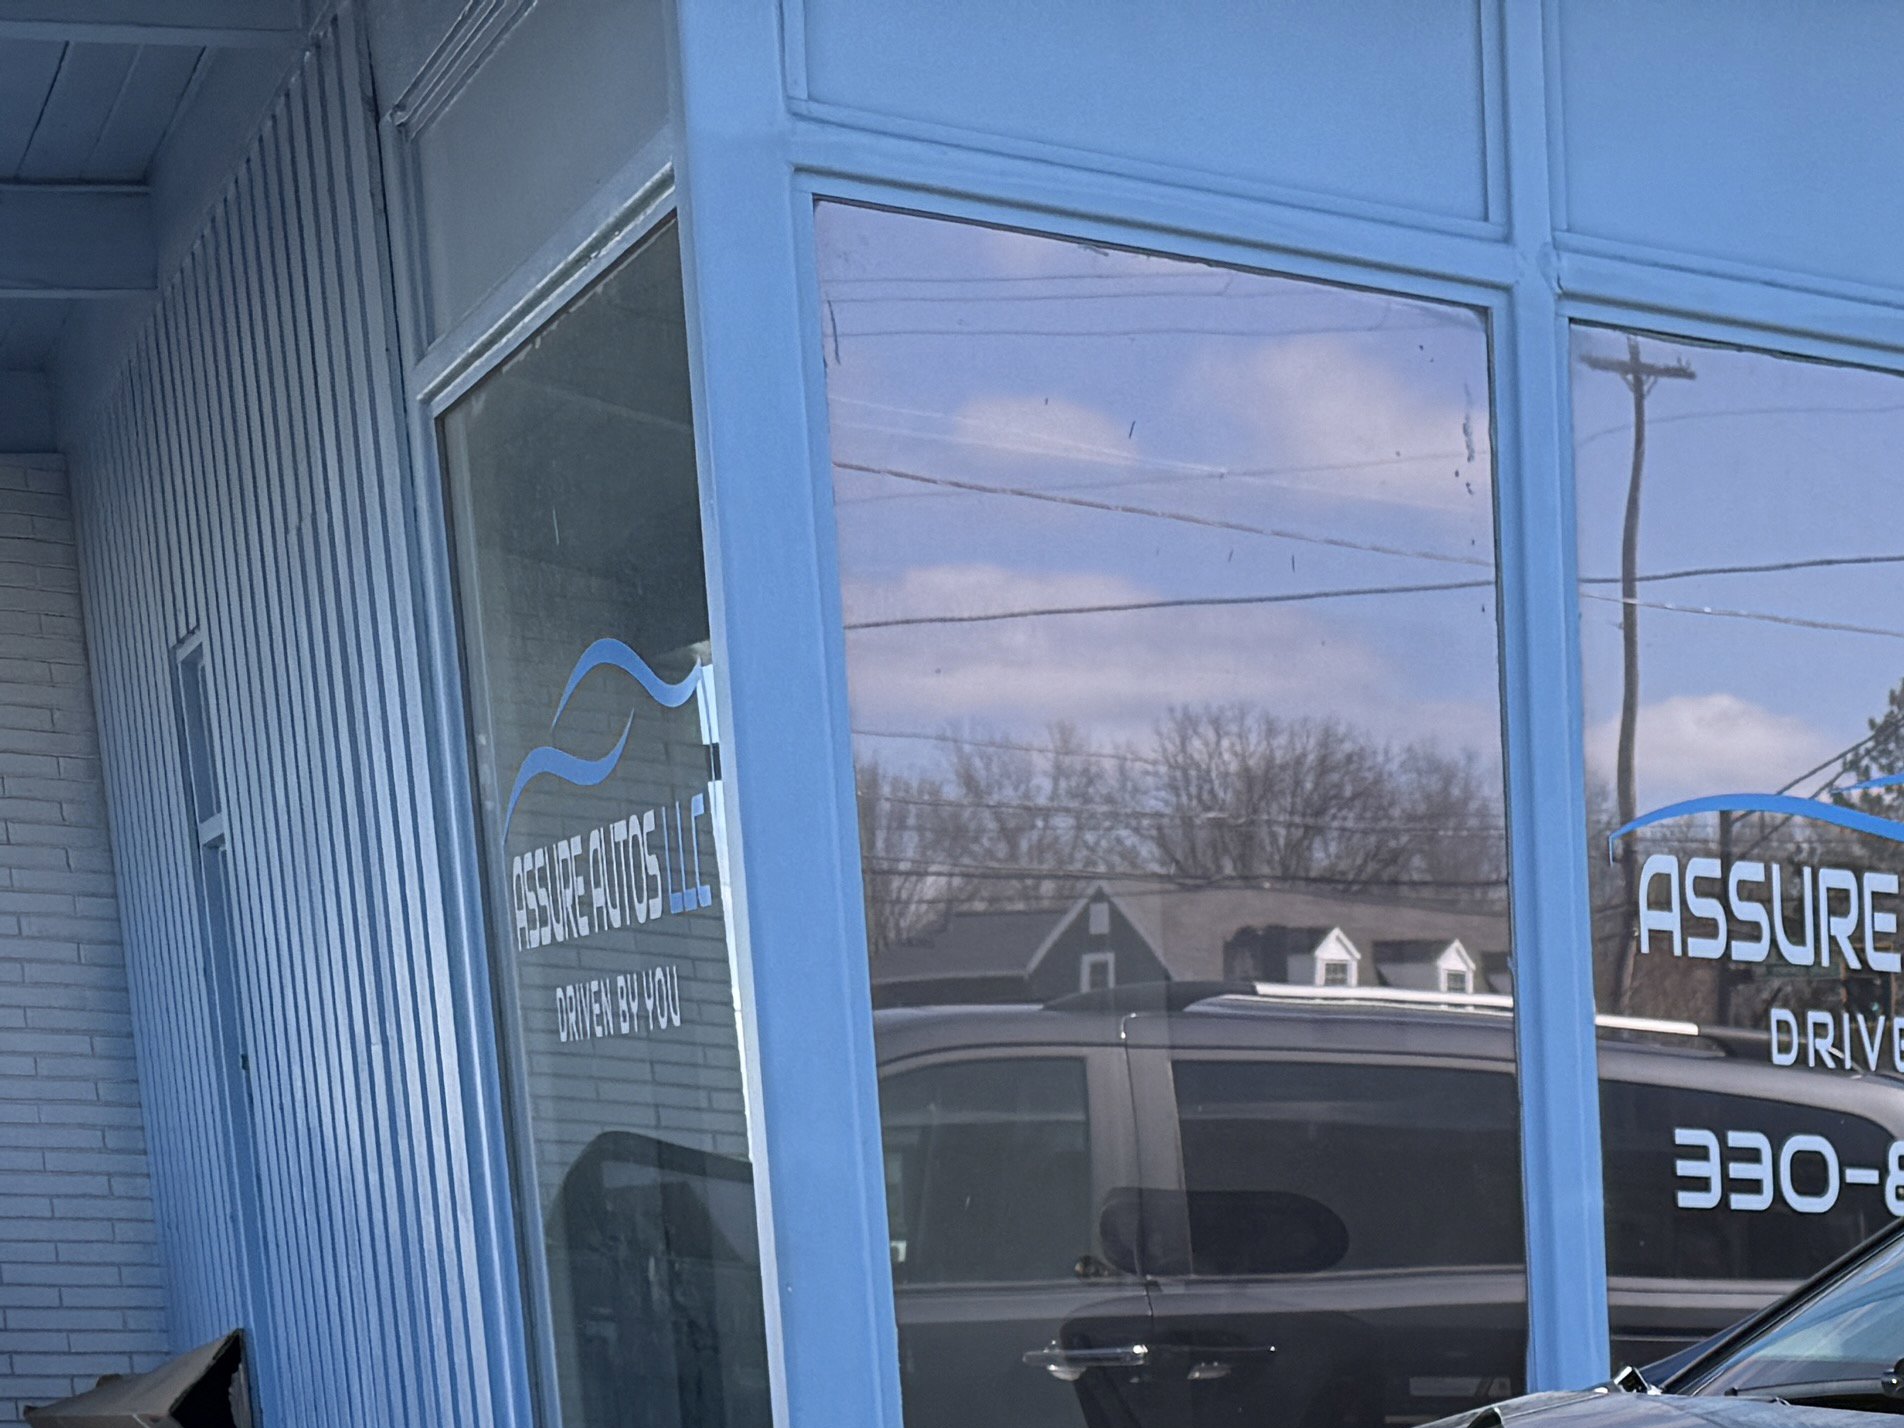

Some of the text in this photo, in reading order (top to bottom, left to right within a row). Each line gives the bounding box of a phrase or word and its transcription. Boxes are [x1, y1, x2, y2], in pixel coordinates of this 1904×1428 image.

[514, 793, 711, 951] ASSURE AUTOS LLC
[1638, 854, 1902, 974] ASSURE
[556, 965, 681, 1042] DRIVEN BY YOU
